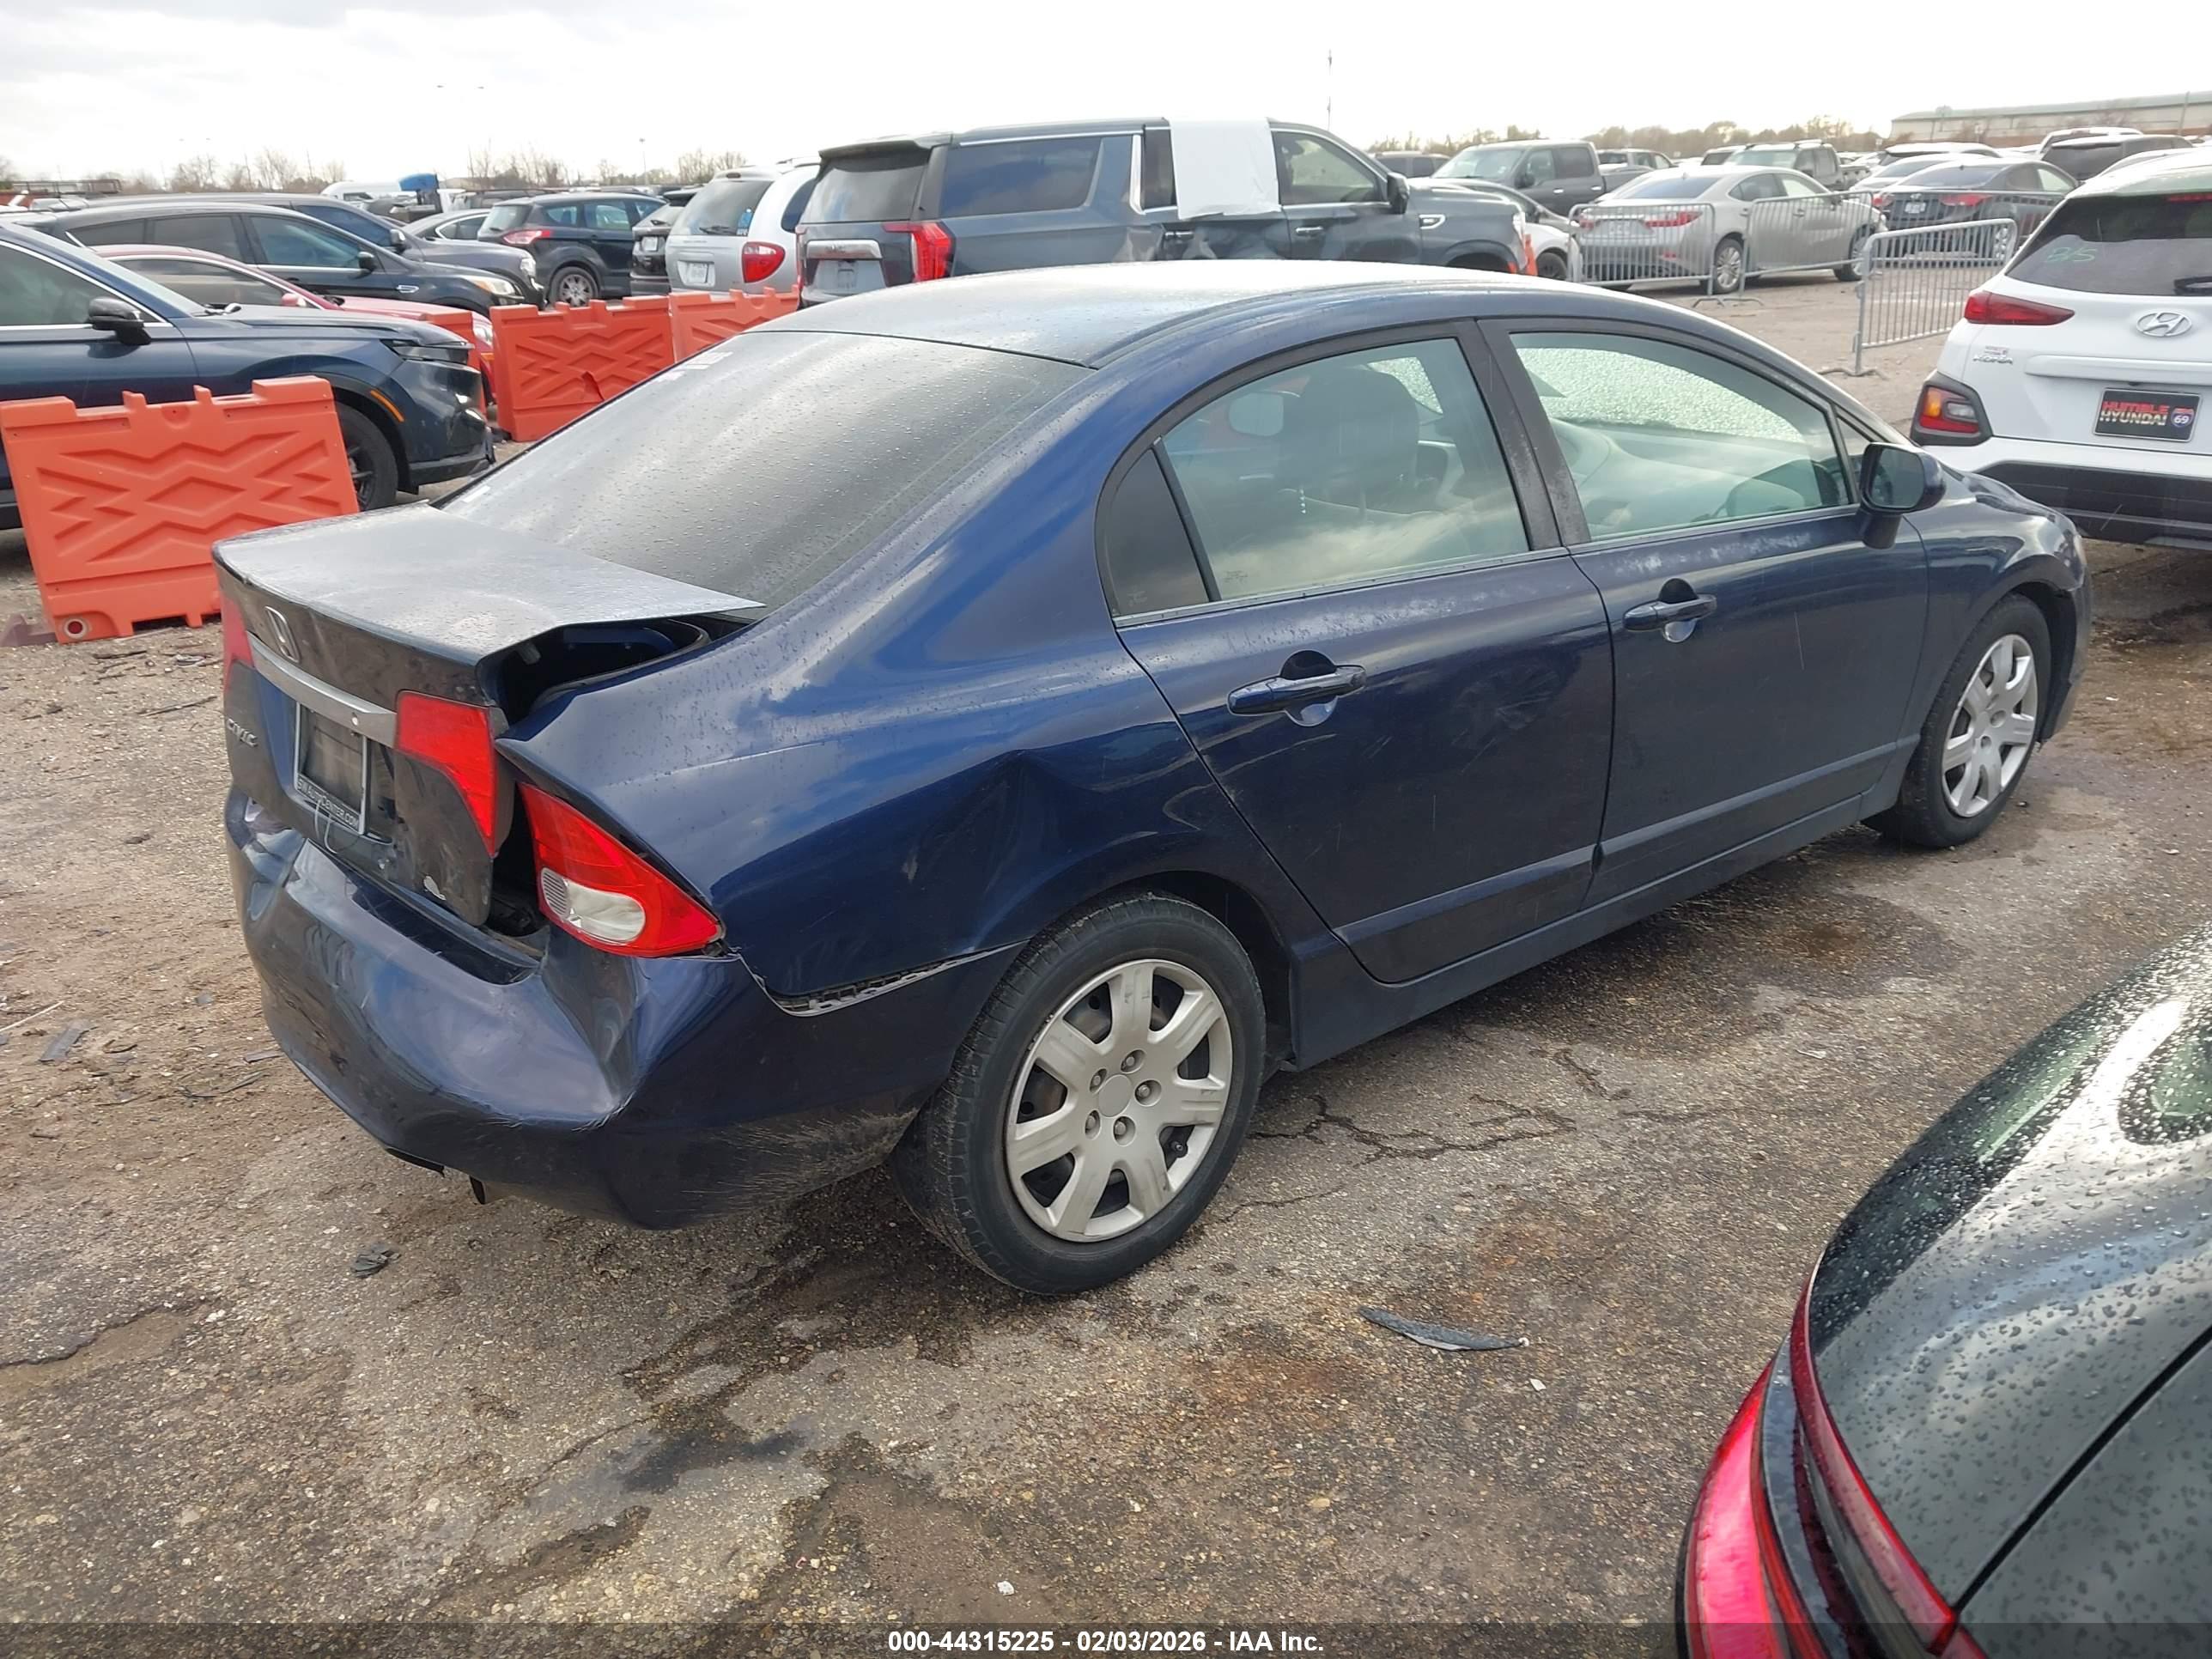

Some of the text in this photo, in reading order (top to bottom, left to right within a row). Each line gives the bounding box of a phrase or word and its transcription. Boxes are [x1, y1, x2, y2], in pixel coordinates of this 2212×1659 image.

[2102, 400, 2170, 415] HUMBLE
[2100, 410, 2167, 426] HYUNDAI
[2173, 415, 2190, 424] 69
